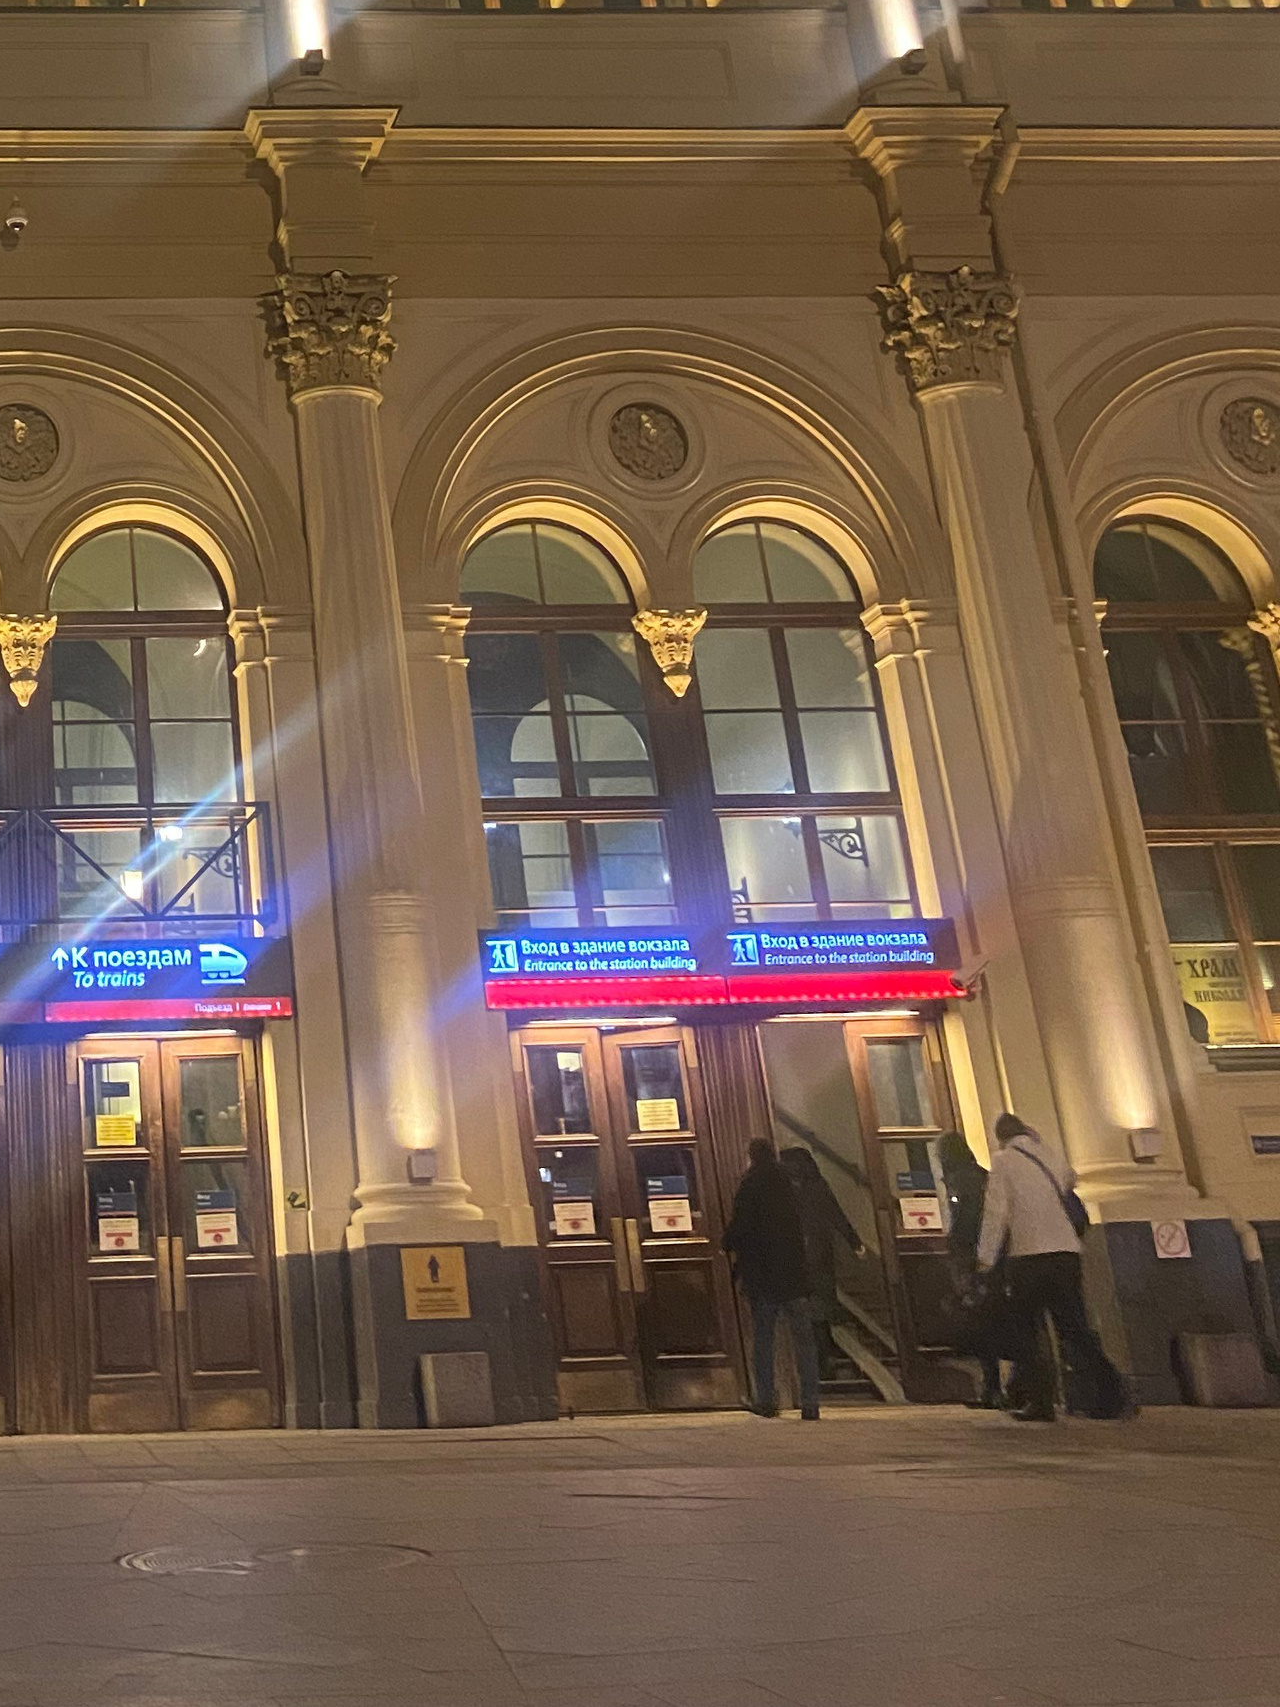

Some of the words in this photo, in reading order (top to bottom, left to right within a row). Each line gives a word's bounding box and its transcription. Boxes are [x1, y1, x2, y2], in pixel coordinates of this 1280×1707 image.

[521, 939, 559, 956] Вход
[559, 943, 569, 954] в
[572, 940, 626, 955] здание
[629, 939, 690, 952] вокзала
[760, 933, 799, 950] Вход
[799, 936, 809, 948] в
[811, 934, 864, 949] здание
[866, 932, 928, 945] вокзала
[71, 946, 89, 968] К
[93, 949, 192, 970] поездам
[524, 959, 573, 971] Entrance
[575, 959, 587, 970] to
[589, 958, 609, 970] the
[609, 957, 649, 969] station
[650, 956, 697, 972] building
[765, 953, 813, 965] Entrance
[815, 953, 827, 964] to
[829, 952, 847, 964] the
[848, 951, 888, 963] station
[889, 950, 935, 963] building
[73, 970, 94, 988] To
[97, 969, 146, 987] trains
[194, 1002, 233, 1013] Подъезд
